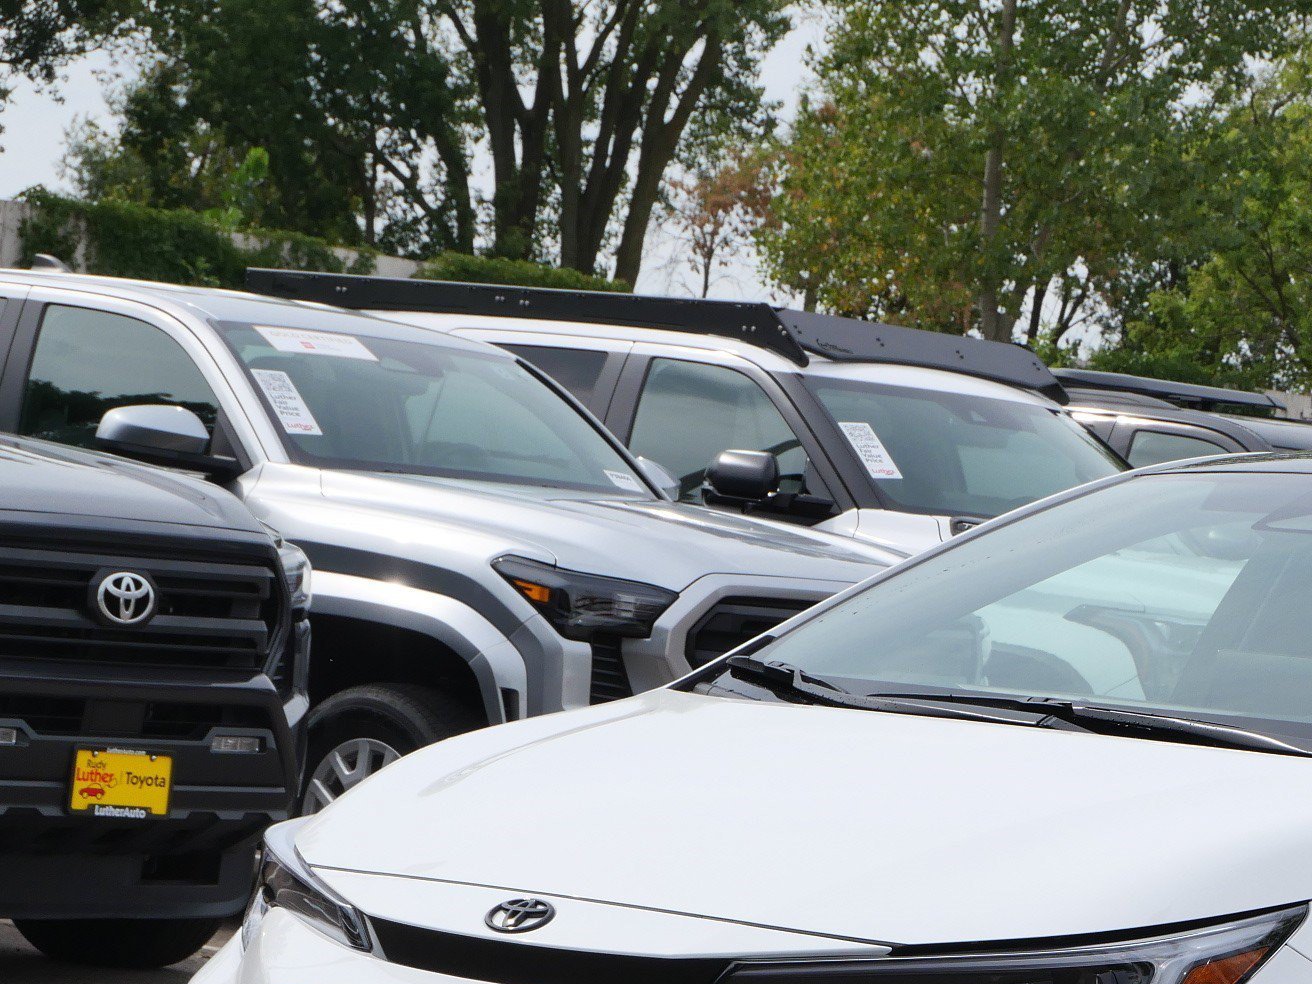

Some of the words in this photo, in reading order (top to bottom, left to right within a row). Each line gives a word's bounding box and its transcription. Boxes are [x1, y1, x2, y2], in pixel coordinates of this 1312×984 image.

[87, 759, 107, 770] Rudy
[76, 767, 115, 783] Luther
[125, 771, 166, 789] Toyota
[95, 805, 146, 818] LutherAuto
